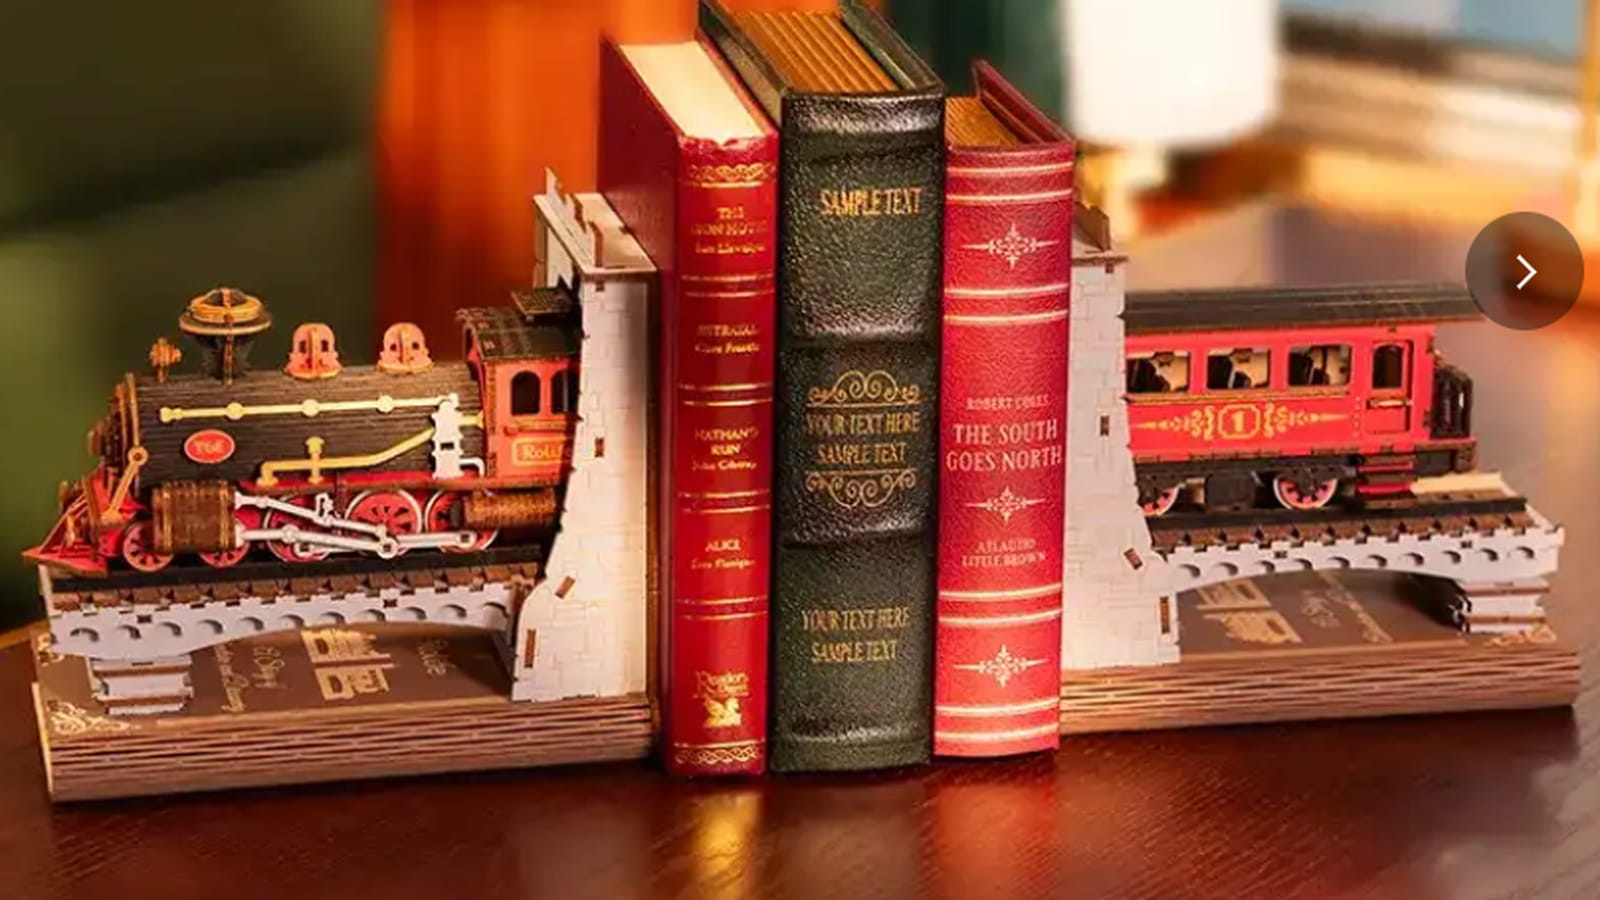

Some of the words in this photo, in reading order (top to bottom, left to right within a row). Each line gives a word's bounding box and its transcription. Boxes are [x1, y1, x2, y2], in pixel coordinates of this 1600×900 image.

[819, 188, 881, 217] SAMPLE
[883, 186, 923, 215] TEXT
[806, 413, 845, 435] YOUR
[848, 413, 884, 434] TEXT
[885, 411, 920, 433] HERE
[952, 423, 992, 445] THE
[999, 419, 1057, 445] SOUTH
[1231, 411, 1246, 433] 1
[817, 443, 872, 464] SAMPLE
[874, 441, 907, 464] TEXT
[946, 450, 996, 472] GOES
[1002, 445, 1062, 472] NORTH
[801, 609, 840, 631] YOUR
[841, 608, 875, 630] TEXT
[878, 606, 910, 629] HERE
[811, 642, 863, 662] SAMPLE
[865, 640, 898, 661] TEXT
